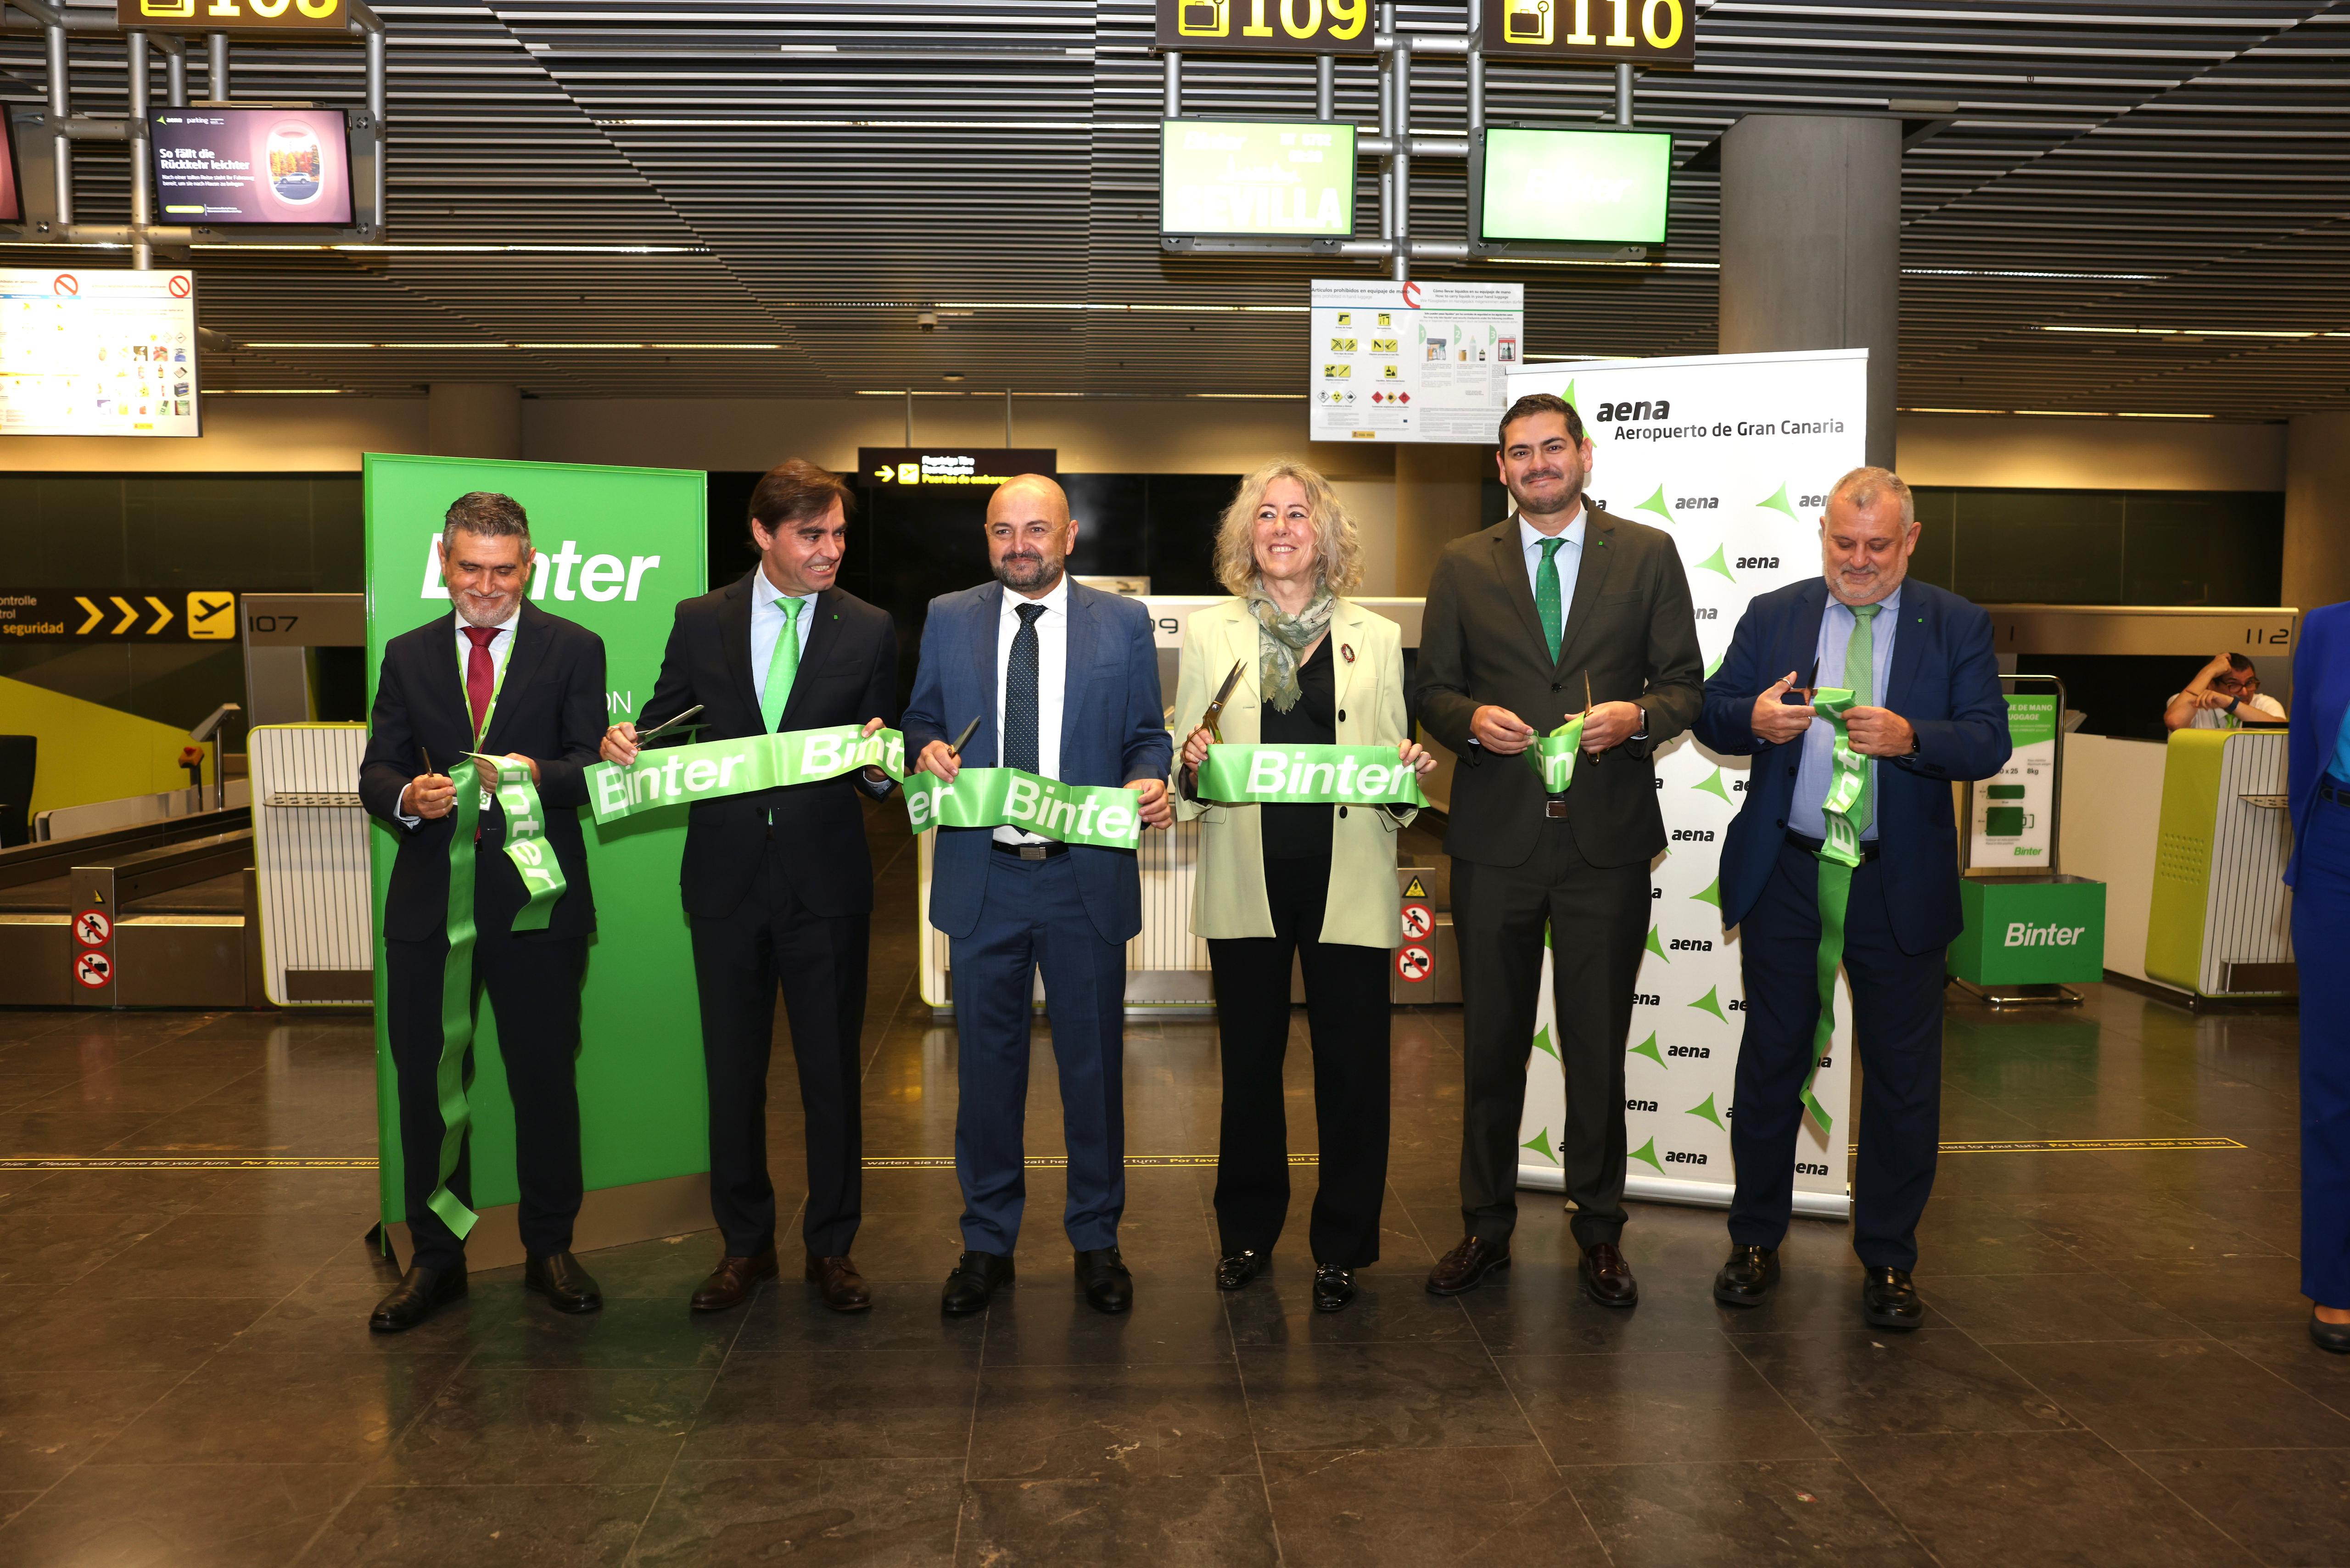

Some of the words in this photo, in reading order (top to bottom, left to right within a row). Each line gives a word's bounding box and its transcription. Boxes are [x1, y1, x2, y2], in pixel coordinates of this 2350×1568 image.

[1242, 0, 1367, 40] 109
[1566, 0, 1683, 49] 110
[159, 149, 173, 158] So
[175, 148, 197, 158] fällt
[198, 149, 215, 158] die
[161, 159, 209, 169] Rückkehr
[211, 160, 250, 169] leichter
[1177, 185, 1343, 228] SEVILLA
[1596, 400, 1670, 422] aena
[1614, 424, 1707, 442] Aeropuerto
[1712, 422, 1732, 437] de
[1737, 420, 1775, 436] Gran
[1781, 418, 1844, 435] Canaria
[1675, 497, 1718, 510] aena
[1736, 556, 1779, 569] aena
[0, 595, 37, 606] ontrolle
[0, 609, 16, 619] trol
[3, 622, 64, 636] seguridad
[249, 616, 298, 633] 107
[2246, 628, 2289, 644] 112
[800, 731, 904, 776] Bint
[1246, 750, 1415, 795] Binter
[596, 754, 744, 815] Binter
[1672, 829, 1715, 842] aena
[2014, 847, 2042, 856] Binter
[2004, 922, 2085, 946] Binter
[1669, 938, 1712, 952] aena
[1632, 994, 1661, 1006] ena
[1667, 1044, 1710, 1058] aena
[1625, 1099, 1658, 1112] ena
[1666, 1151, 1707, 1165] aena
[1793, 1162, 1829, 1176] ena
